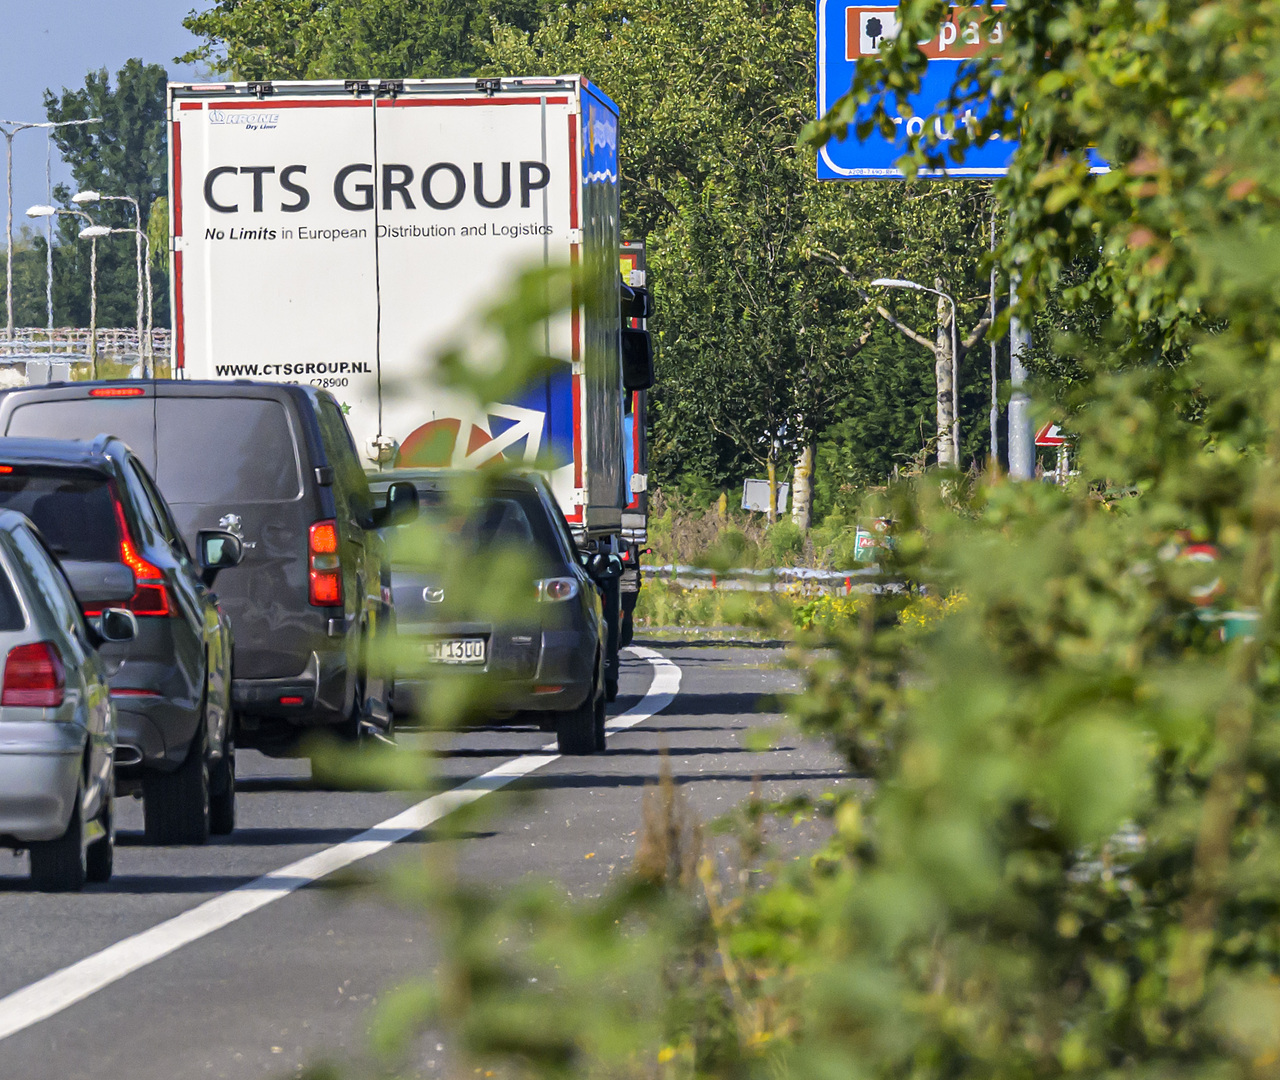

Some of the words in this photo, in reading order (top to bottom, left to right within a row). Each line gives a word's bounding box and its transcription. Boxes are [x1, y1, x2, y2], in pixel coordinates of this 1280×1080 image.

[226, 113, 280, 124] KRONE
[203, 164, 310, 213] CTS
[333, 160, 551, 212] GROUP
[204, 228, 225, 240] No
[229, 227, 277, 240] Limits
[281, 227, 294, 240] in
[298, 226, 367, 242] European
[376, 224, 456, 238] Distribution
[460, 223, 487, 236] and
[491, 222, 554, 238] Logistics
[215, 362, 372, 377] WWW.CTSGROUP.NL
